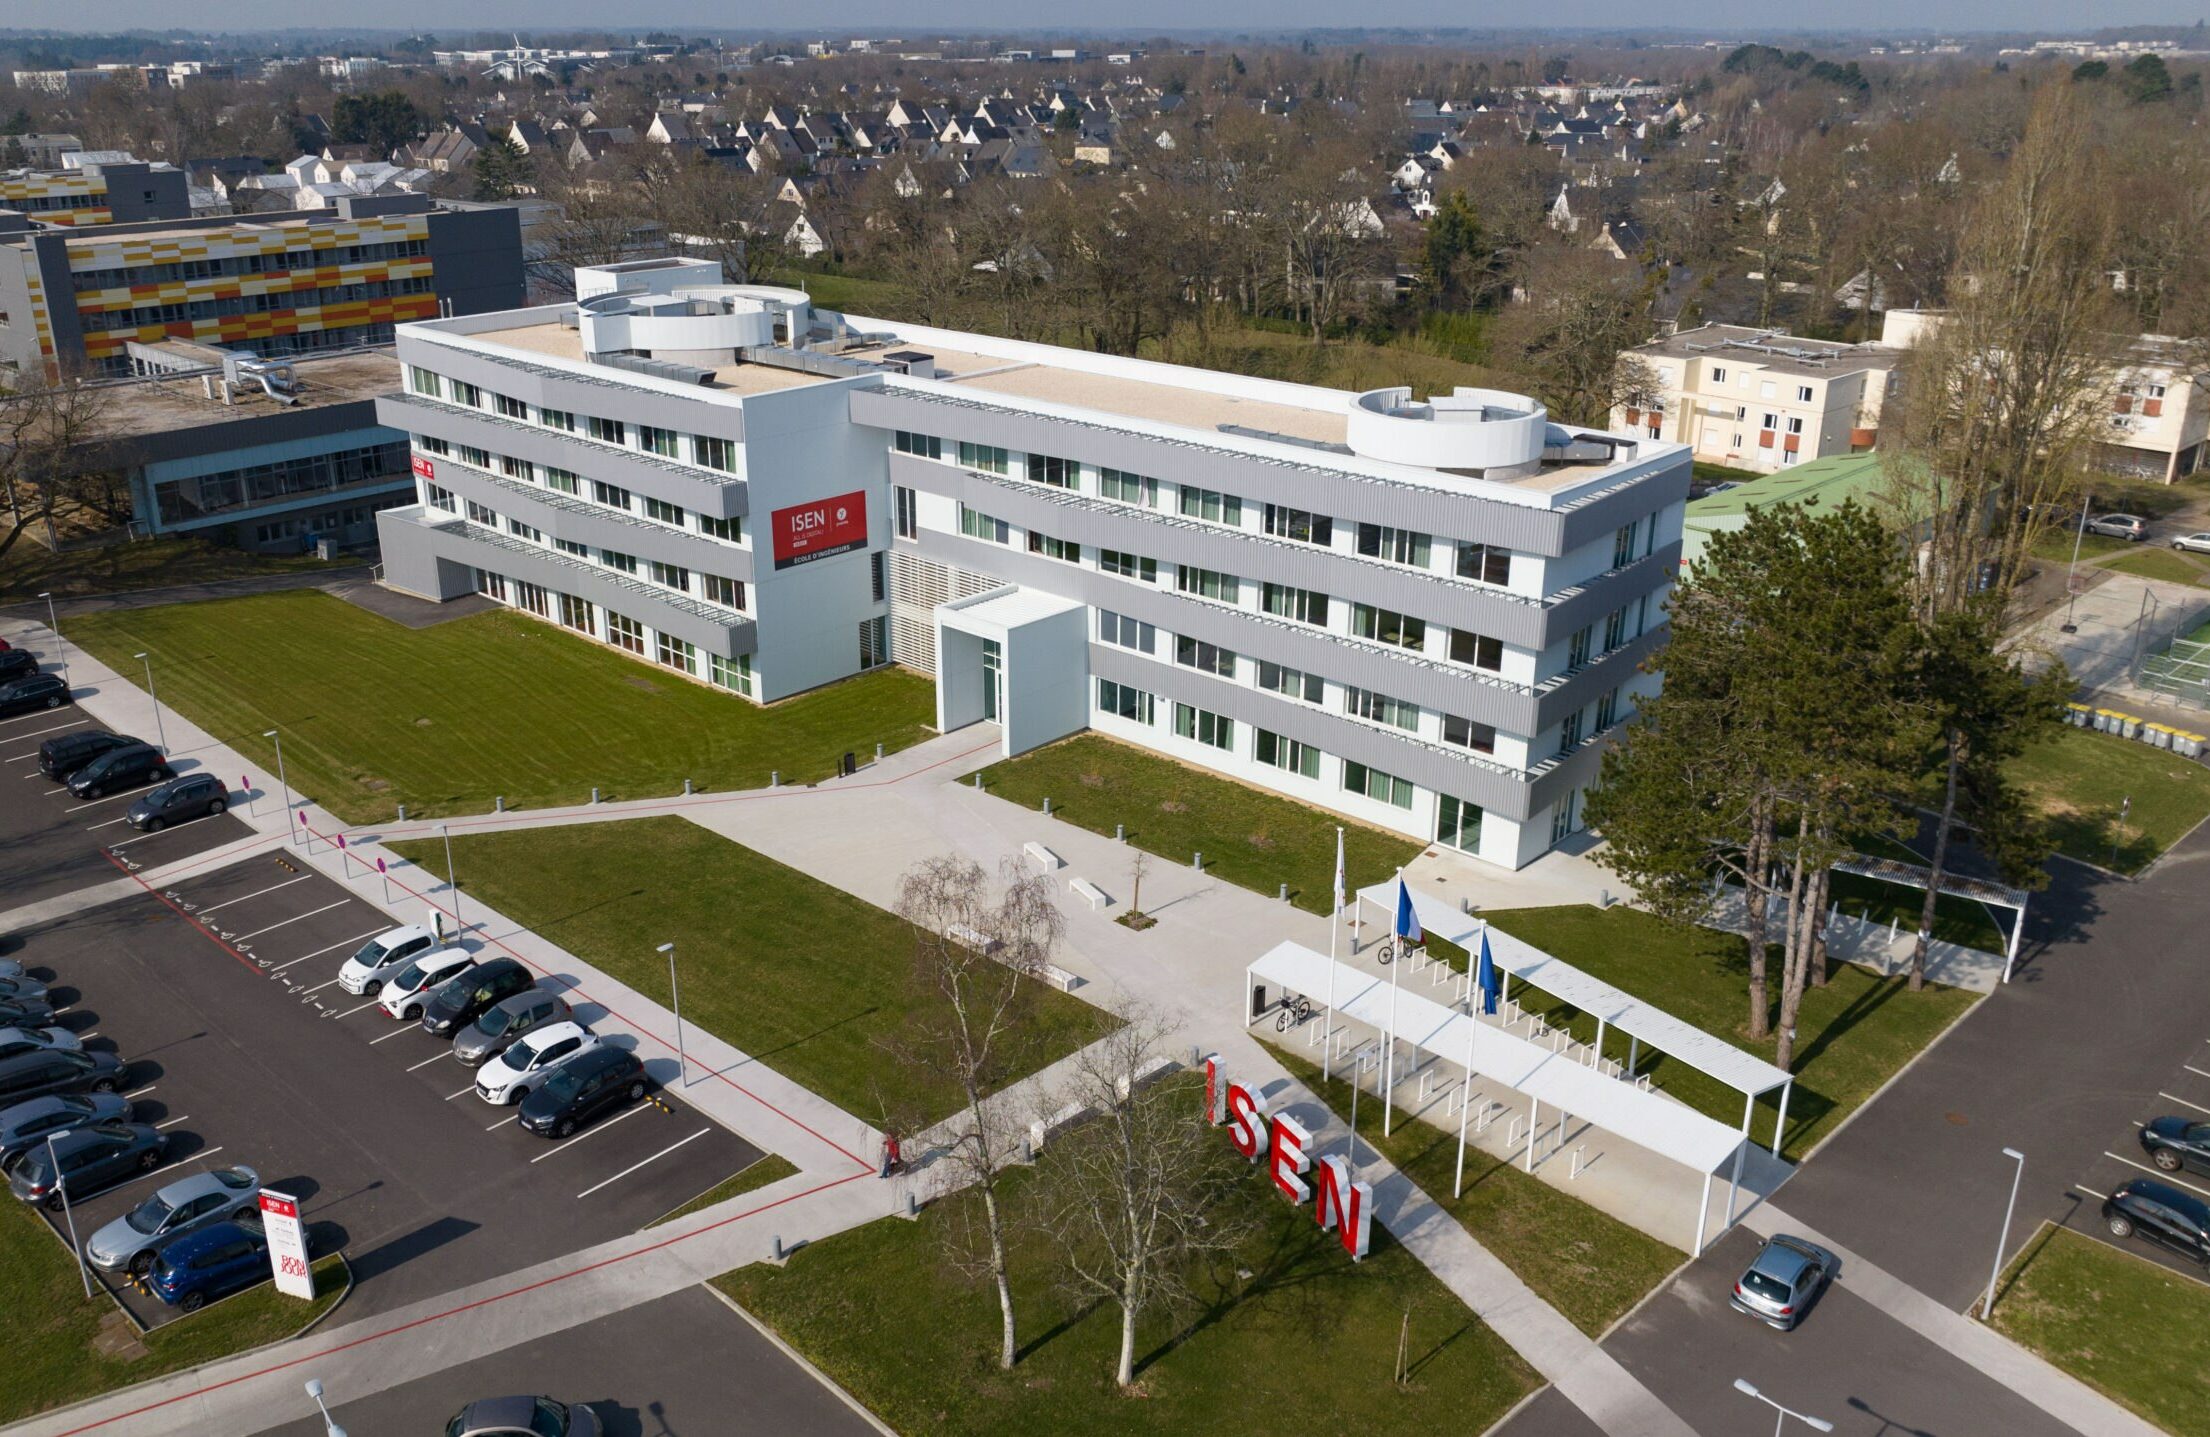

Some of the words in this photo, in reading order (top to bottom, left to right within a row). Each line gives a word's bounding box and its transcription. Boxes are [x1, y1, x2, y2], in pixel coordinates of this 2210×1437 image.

[791, 509, 825, 533] ISEN
[794, 554, 812, 564] ÉCOLE
[812, 544, 850, 560] D'INGÉNIEURS
[1206, 1055, 1373, 1260] ISEN
[266, 1199, 280, 1209] ISEN
[280, 1262, 307, 1278] JOUR
[281, 1255, 305, 1270] BON
